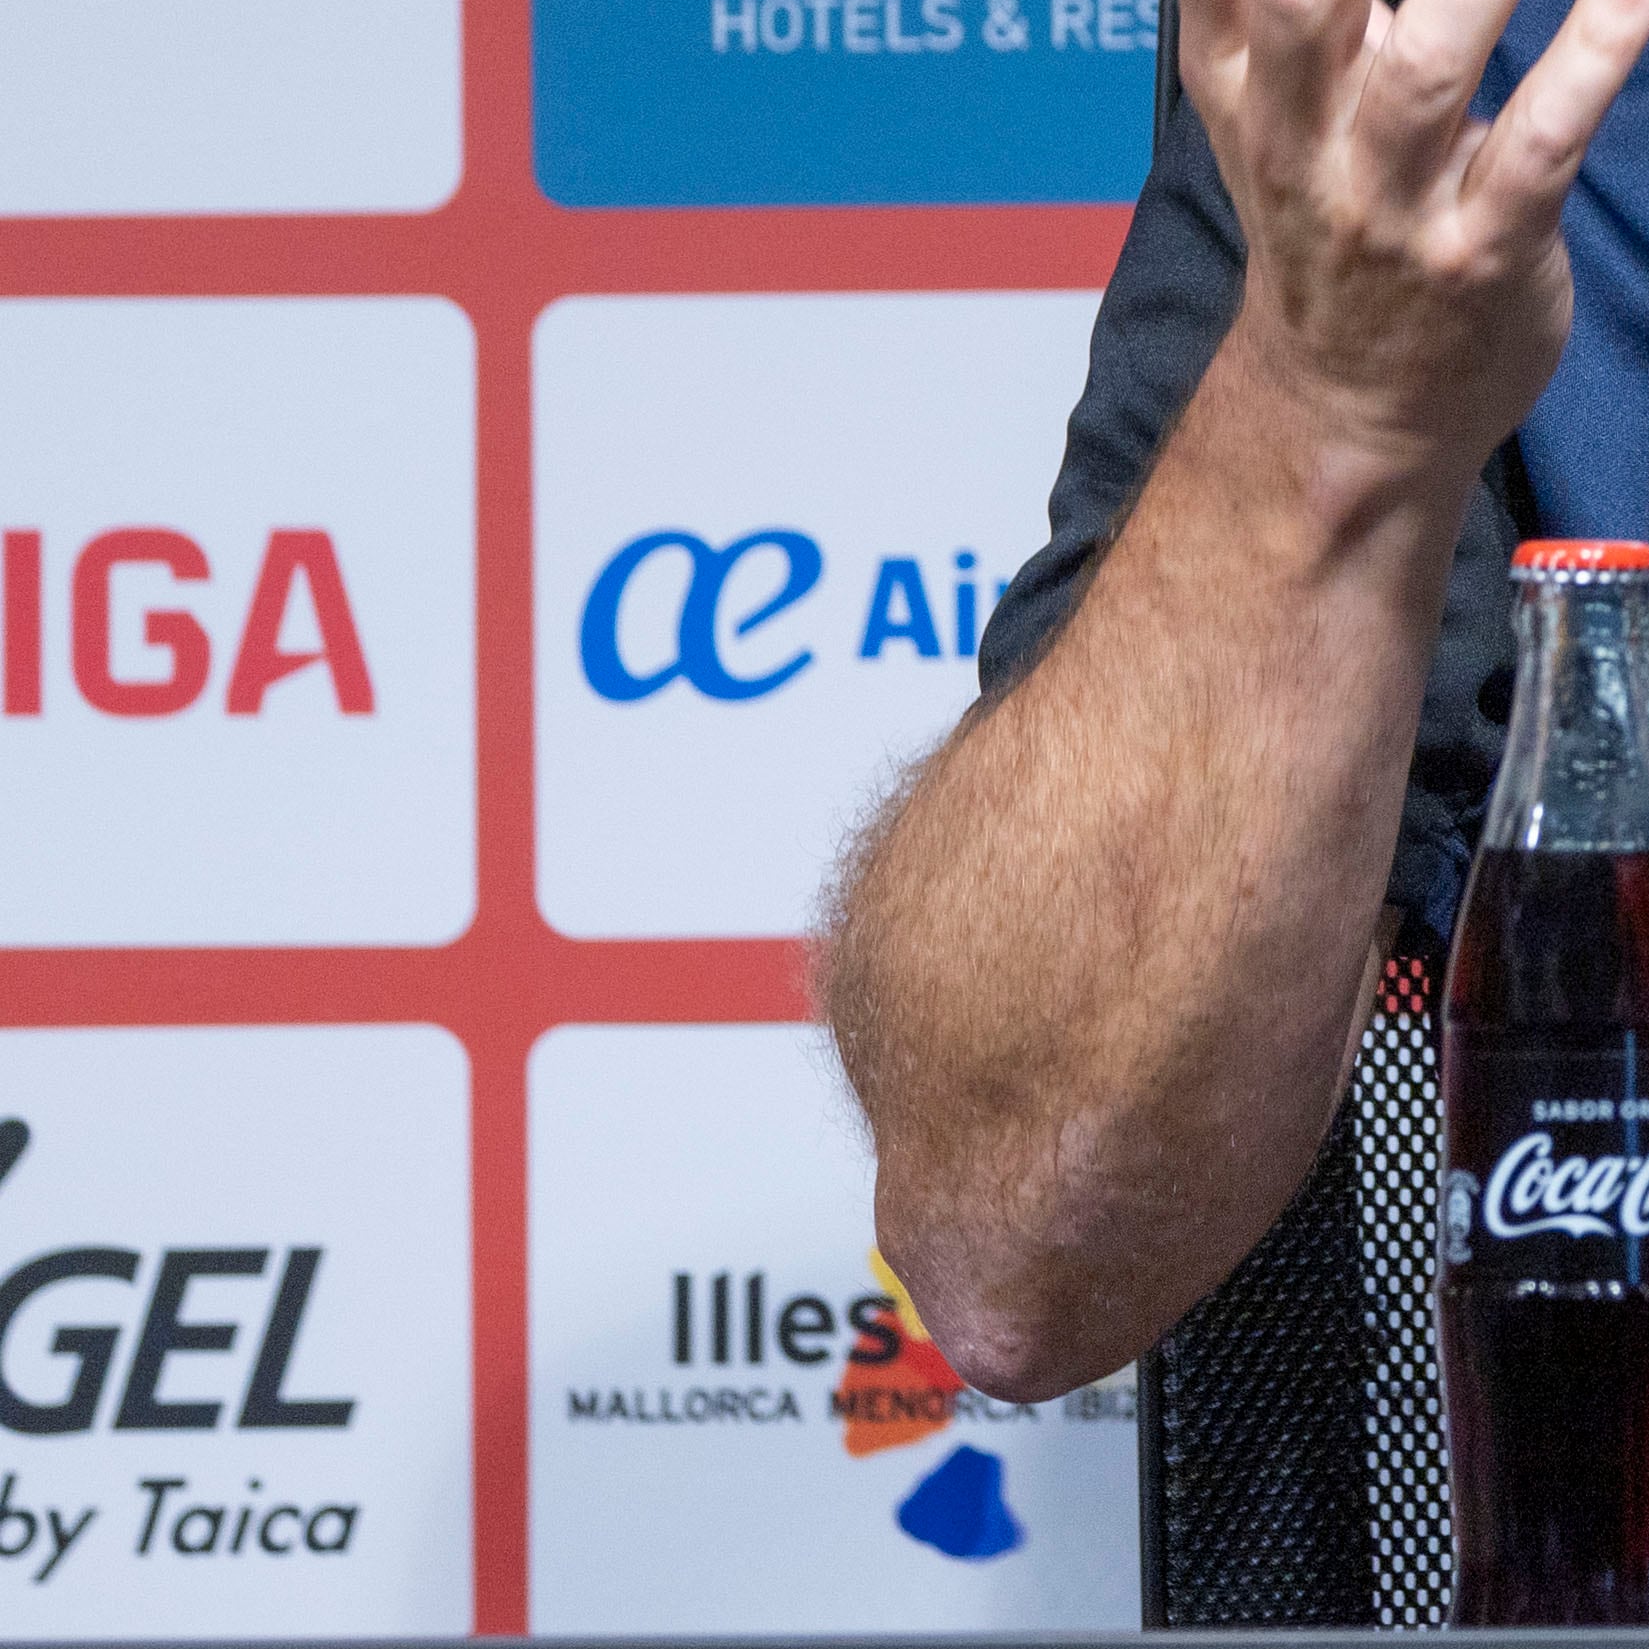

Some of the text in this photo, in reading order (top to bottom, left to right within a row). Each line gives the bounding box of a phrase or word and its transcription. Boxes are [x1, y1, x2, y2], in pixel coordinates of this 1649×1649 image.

[858, 551, 1012, 661] Ai
[1533, 1100, 1615, 1122] SABOR
[567, 1388, 802, 1424] MALLORCA
[135, 1477, 360, 1558] Taica
